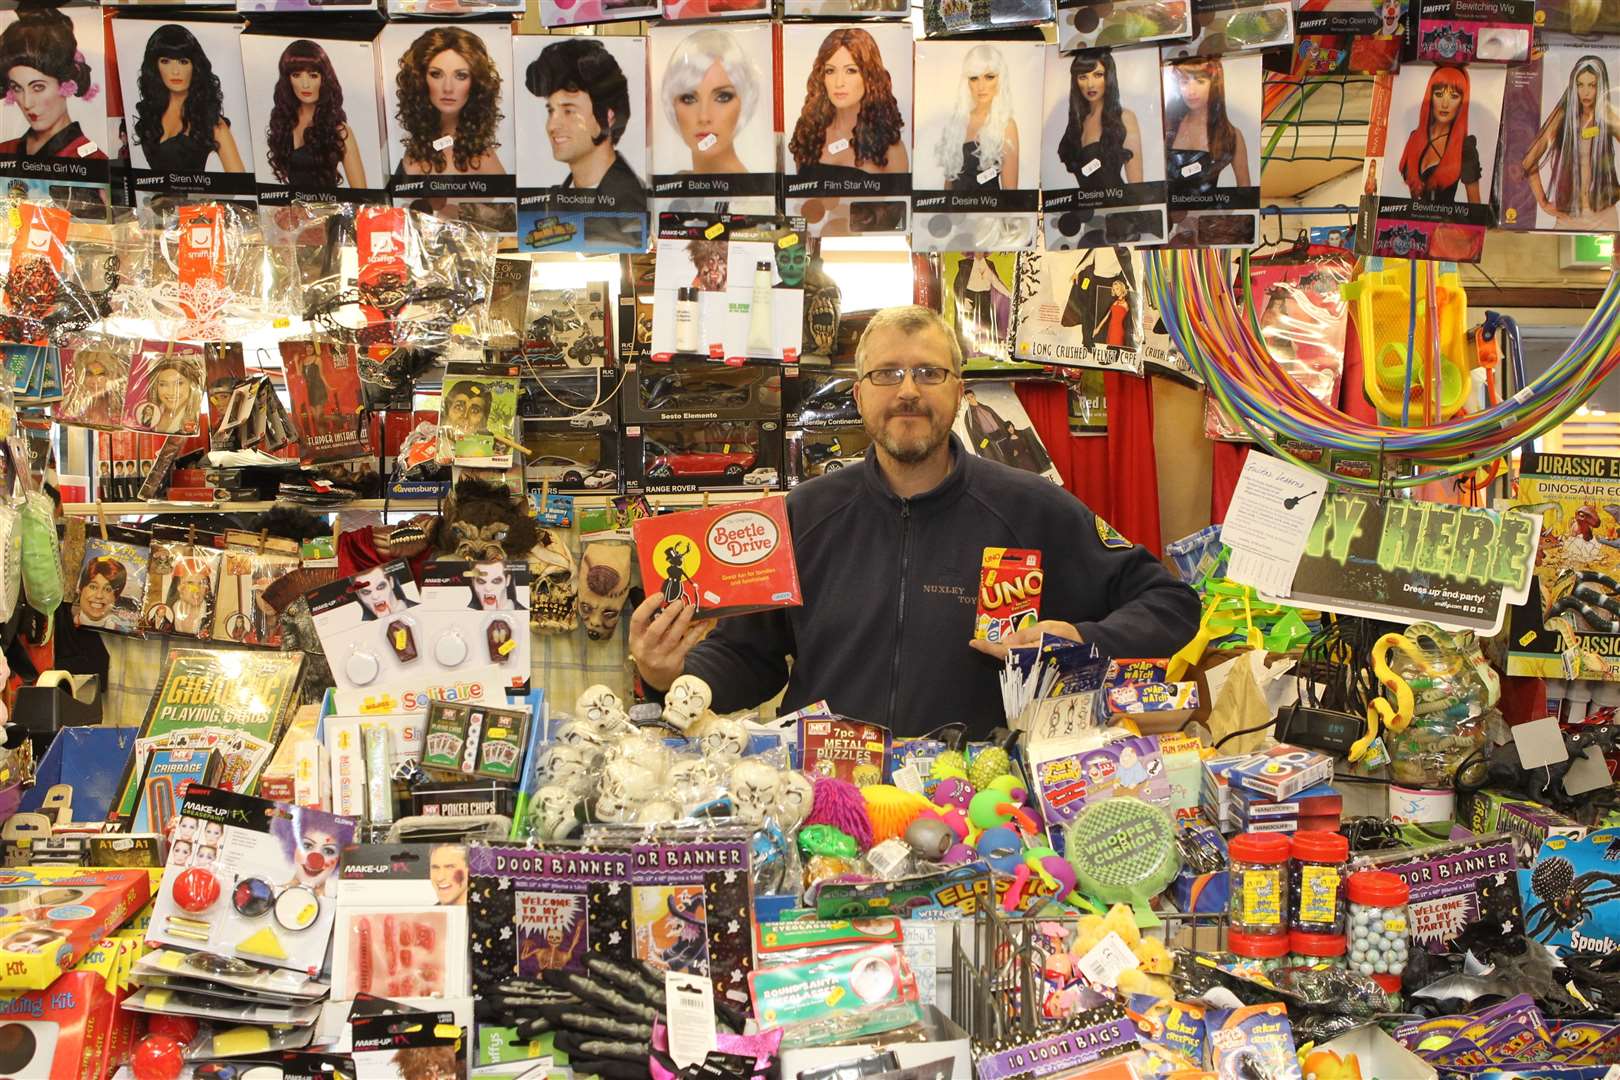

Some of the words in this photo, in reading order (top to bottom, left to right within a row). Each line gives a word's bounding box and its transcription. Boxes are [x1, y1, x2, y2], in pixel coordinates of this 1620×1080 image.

[1456, 1, 1498, 13] Bewitching
[1500, 2, 1515, 14] Wig
[22, 162, 51, 172] Geisha
[53, 162, 68, 173] Girl
[70, 164, 87, 176] Wig
[136, 176, 165, 185] SMIFFY'S
[169, 173, 192, 184] Siren
[193, 174, 211, 186] Wig
[430, 181, 467, 190] Glamour
[469, 181, 487, 192] Wig
[688, 181, 711, 190] Babe
[712, 181, 729, 192] Wig
[823, 181, 842, 190] Film
[844, 181, 862, 190] Star
[863, 181, 881, 192] Wig
[260, 191, 289, 200] SMIFFY'S
[557, 194, 596, 205] Rockstar
[597, 195, 616, 206] Wig
[1078, 190, 1104, 200] Desire
[1106, 188, 1123, 198] Wig
[1171, 194, 1214, 203] Babelicious
[1215, 194, 1230, 204] Wig
[951, 197, 978, 206] Desire
[980, 197, 998, 207] Wig
[1412, 202, 1453, 215] Bewitching
[1454, 205, 1469, 217] Wig
[1033, 341, 1052, 356] LONG
[1056, 342, 1087, 360] CRUSHED
[1120, 350, 1137, 365] CAPE
[661, 412, 682, 420] Sesto
[683, 412, 718, 420] Elemento
[804, 418, 827, 427] Bentley
[828, 417, 863, 426] Continental
[1536, 456, 1605, 476] JURASSIC
[645, 485, 669, 493] RANGE
[670, 484, 696, 492] ROVER
[1539, 483, 1605, 495] DINOSAUR
[714, 523, 765, 546] Beetle
[727, 538, 772, 558] Drive
[1377, 498, 1534, 594] HERE
[923, 585, 966, 595] NUXLEY
[981, 570, 1043, 610] UNO
[1403, 583, 1428, 594] Dress
[1429, 587, 1440, 598] up
[1442, 588, 1458, 600] and
[1459, 592, 1486, 603] party!
[402, 681, 482, 709] Solitaire
[160, 706, 221, 723] PLAYING
[833, 728, 855, 738] 7pc
[824, 738, 865, 749] METAL
[816, 748, 871, 761] PUZZLES
[153, 763, 203, 774] CRIBBAGE
[183, 801, 228, 816] MAKE-UP
[441, 803, 468, 817] POKER
[469, 801, 496, 815] CHIPS
[1085, 819, 1155, 856] WHOOPEE
[1093, 833, 1158, 865] CUSHION
[667, 848, 741, 866] BANNER
[344, 864, 389, 874] MAKE-UP
[496, 853, 543, 872] DOOR
[552, 858, 626, 877] BANNER
[1439, 852, 1509, 878] BANNER
[520, 897, 571, 907] WELCOME
[1413, 900, 1463, 916] WELCOME
[522, 906, 537, 914] TO
[543, 907, 559, 916] MY
[521, 914, 565, 924] PARTY!
[1417, 915, 1430, 925] TO
[1436, 911, 1451, 920] MY
[1416, 916, 1458, 934] PARTY!
[6, 961, 28, 976] Kit
[51, 992, 76, 1009] Kit
[355, 1037, 391, 1047] MAKE-UP
[1007, 1055, 1024, 1069] 10
[1029, 1042, 1070, 1062] LOOT
[1075, 1025, 1121, 1050] BAGS
